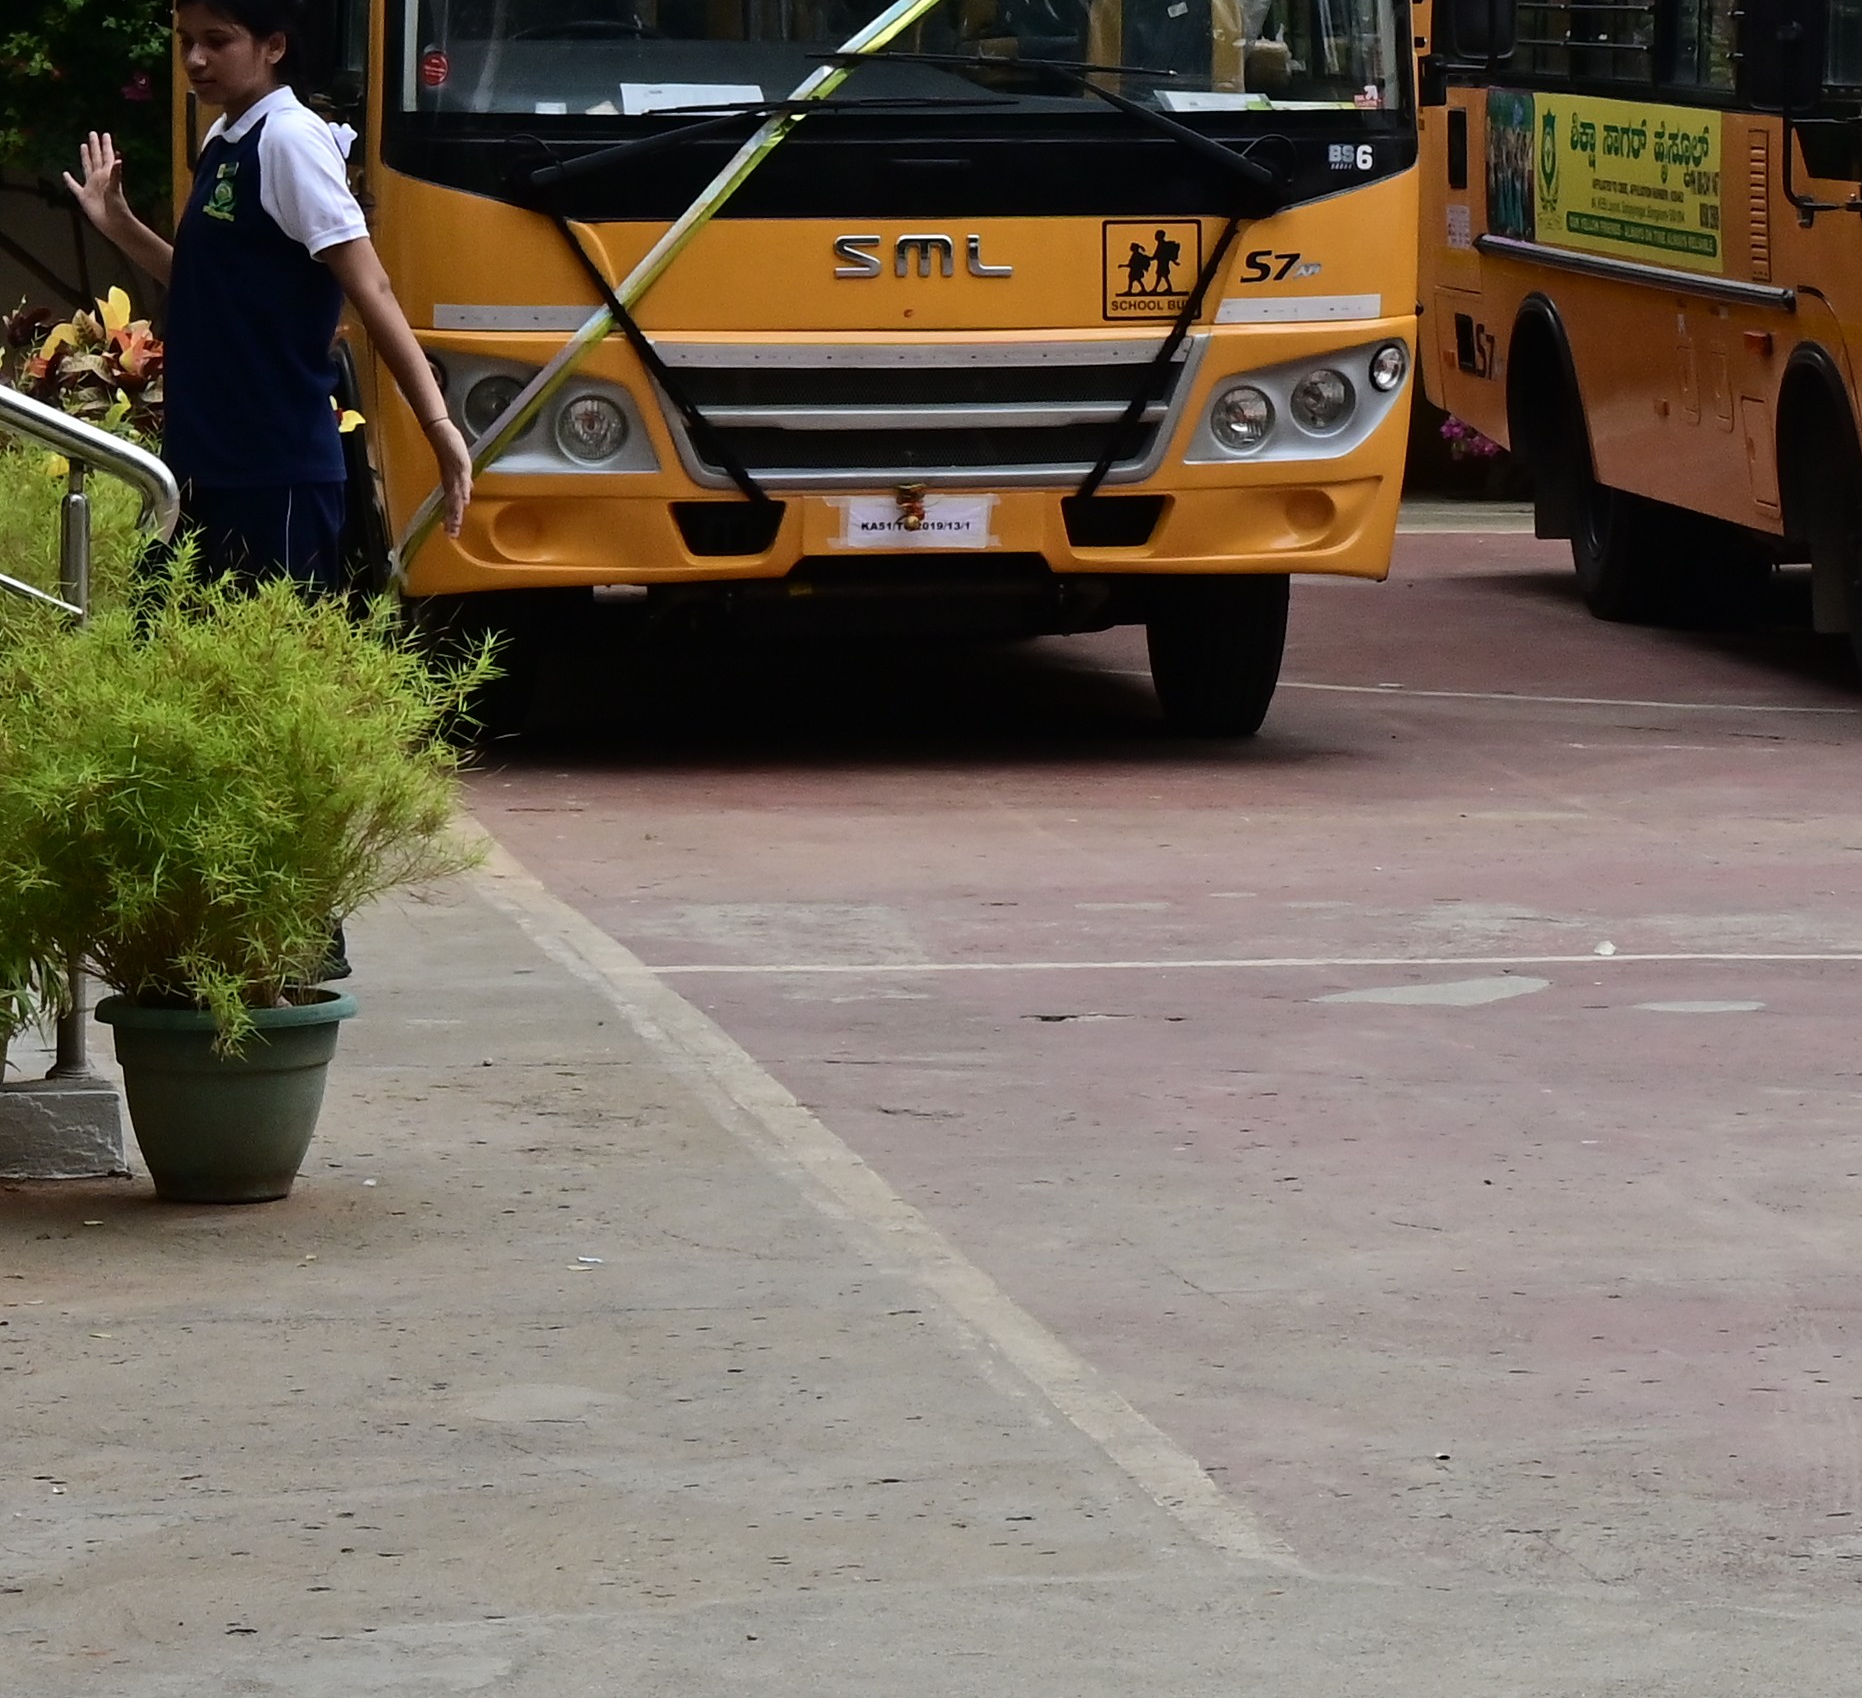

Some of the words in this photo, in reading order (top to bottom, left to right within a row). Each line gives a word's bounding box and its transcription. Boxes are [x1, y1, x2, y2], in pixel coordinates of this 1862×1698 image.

[832, 233, 1013, 278] SML
[1240, 249, 1301, 283] S7
[1111, 299, 1164, 311] SCHOOL
[1167, 299, 1186, 311] BU
